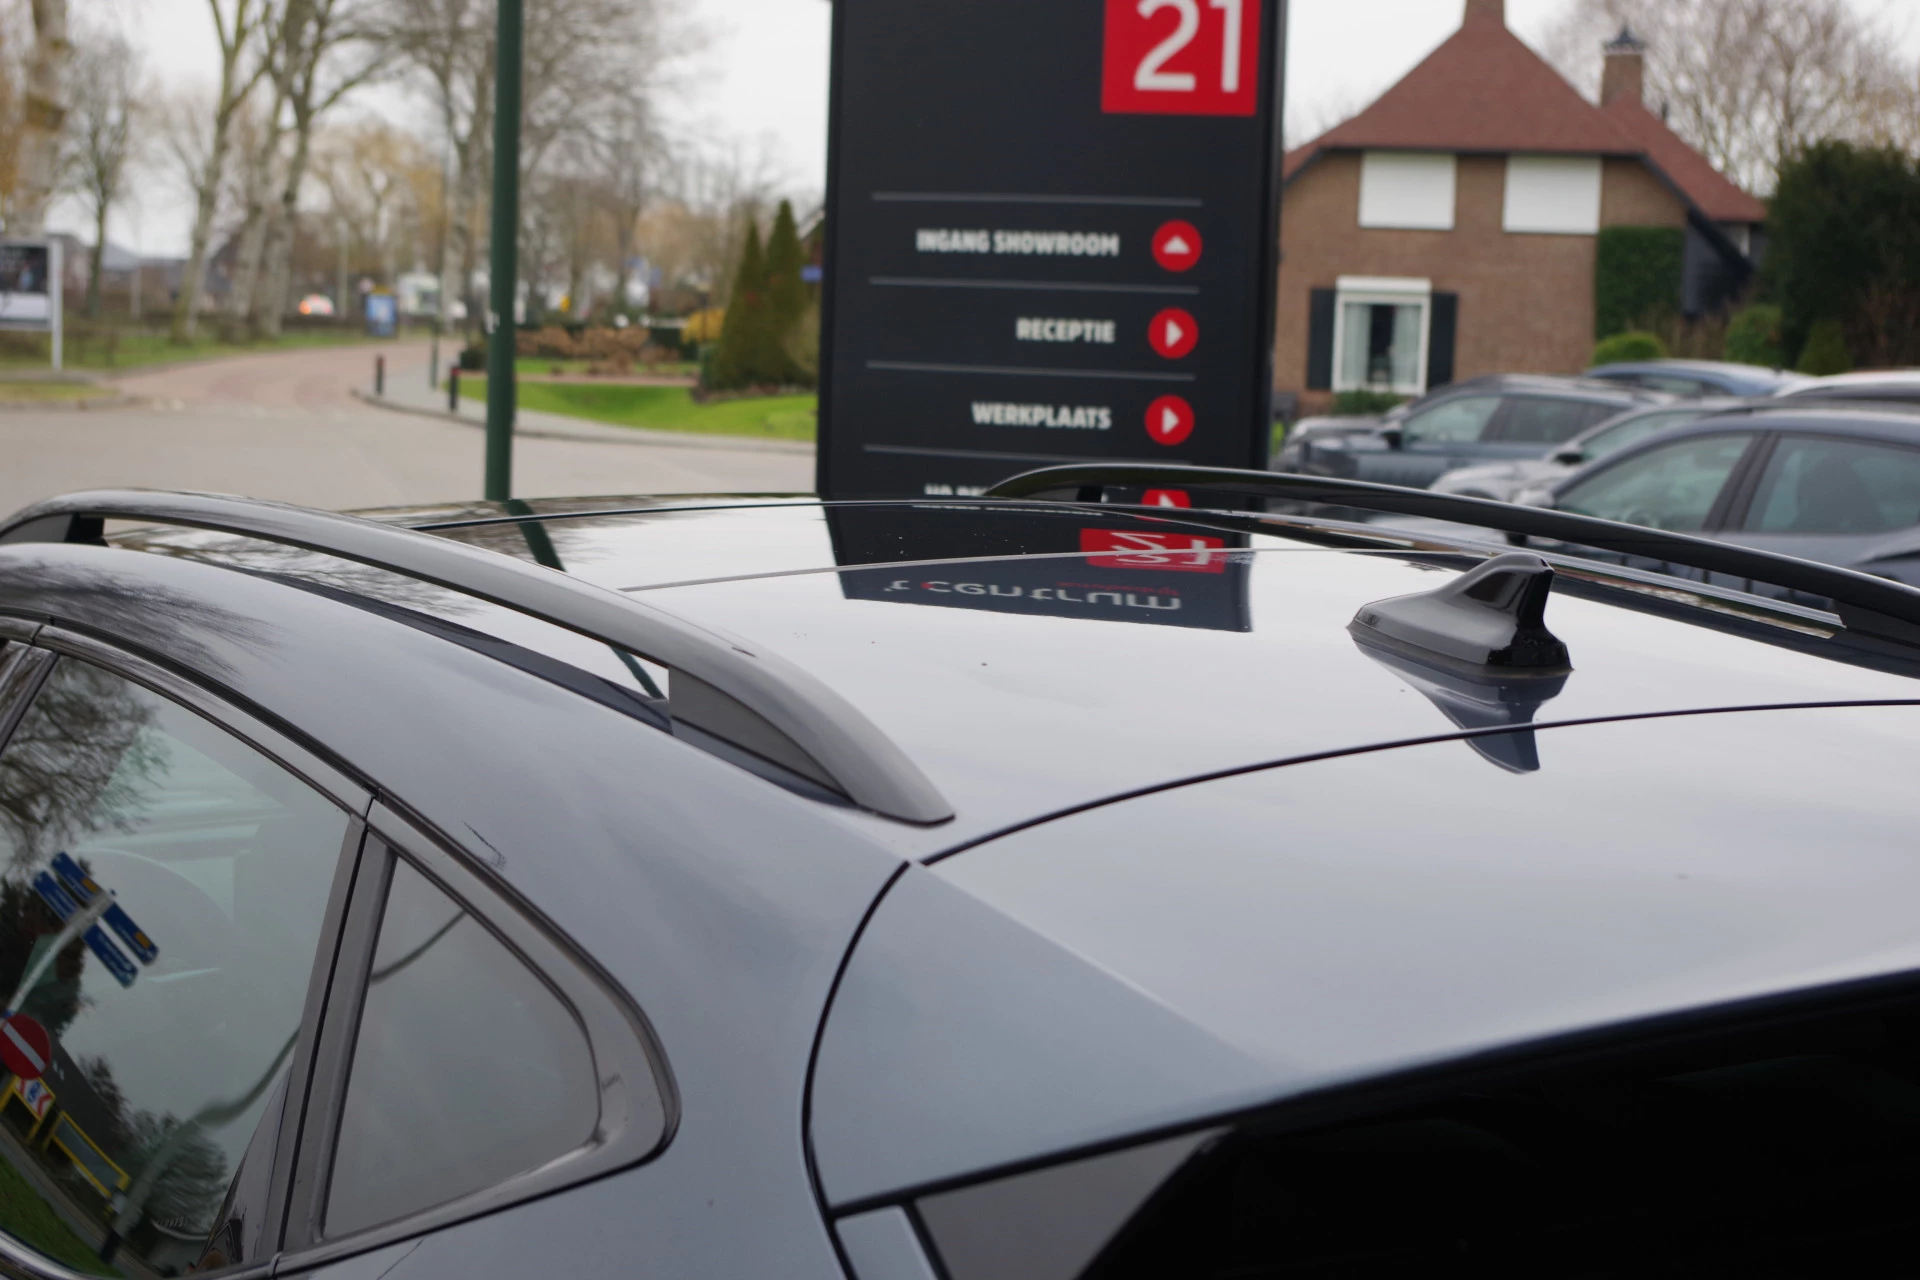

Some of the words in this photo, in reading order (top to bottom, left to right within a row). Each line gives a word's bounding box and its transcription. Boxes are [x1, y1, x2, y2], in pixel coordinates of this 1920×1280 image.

[1134, 0, 1242, 93] 21
[915, 229, 990, 253] INGANG
[993, 230, 1120, 256] SHOWROOM
[1015, 318, 1116, 343] RECEPTIE
[971, 402, 1113, 430] WERKPLAATS
